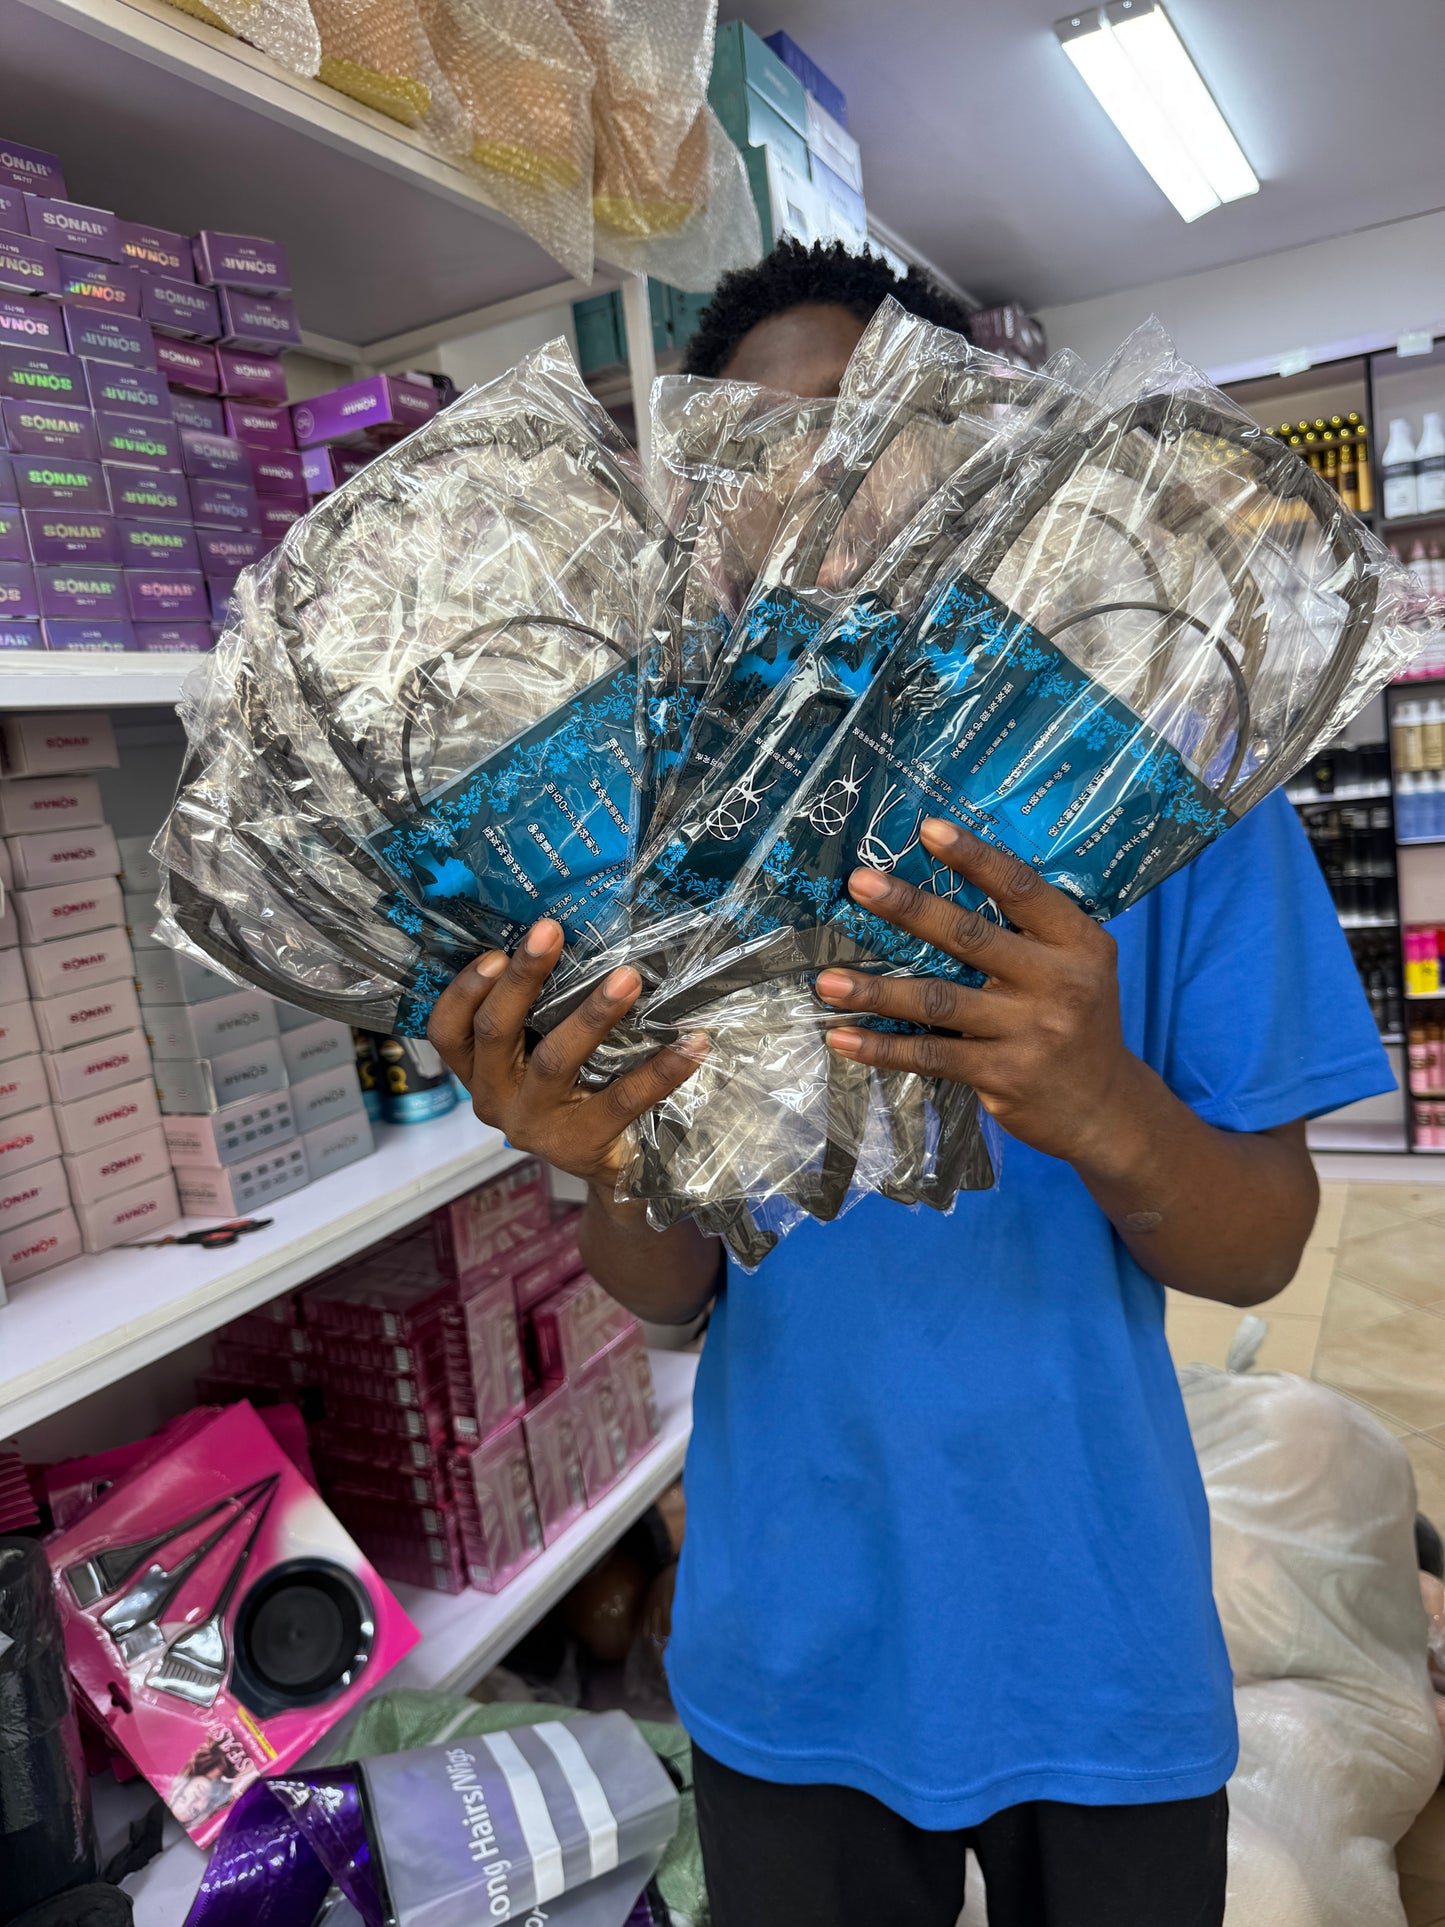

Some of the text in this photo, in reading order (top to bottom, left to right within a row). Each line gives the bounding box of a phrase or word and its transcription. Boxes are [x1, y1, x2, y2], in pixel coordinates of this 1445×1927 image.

[0, 152, 49, 176] ONAR
[43, 212, 104, 235] SONAR
[126, 244, 180, 268] SONAR
[225, 257, 277, 274] SONAR
[70, 281, 126, 303] SONAR
[154, 288, 206, 310] SONAR
[0, 316, 49, 335] SONA
[244, 313, 290, 331] SONAR
[85, 332, 141, 352] SONAR
[159, 349, 201, 367] SONAR
[12, 371, 72, 390] SONAR
[234, 365, 271, 378] SONAR
[105, 386, 158, 405] SONAR
[20, 415, 80, 433] SONAR
[242, 417, 277, 430] SONAR
[112, 437, 167, 456] SONAR
[193, 444, 239, 460] SONAR
[28, 469, 88, 486] SONAR
[125, 491, 177, 507] SONAR
[43, 524, 101, 539] SONAR
[130, 531, 183, 547] SONAR
[209, 542, 254, 556] SONAR
[53, 578, 112, 595] SONAR
[140, 582, 192, 597] SONAR
[46, 736, 90, 748] SONAR
[589, 777, 630, 835] 安装简单收纳
[544, 782, 602, 858] 方便轻巧不占空间
[527, 822, 572, 880] 展示放置晾晒
[481, 825, 540, 900] 支撑保护假发发型
[51, 900, 96, 918] SONAR
[62, 952, 107, 971] SONAR
[70, 1003, 112, 1024] SONAR
[85, 1054, 130, 1075] SONAR
[95, 1103, 138, 1126] SONAR
[100, 1154, 143, 1177] SONAR
[113, 1201, 157, 1225] SONAR
[10, 1236, 59, 1263] SONAR
